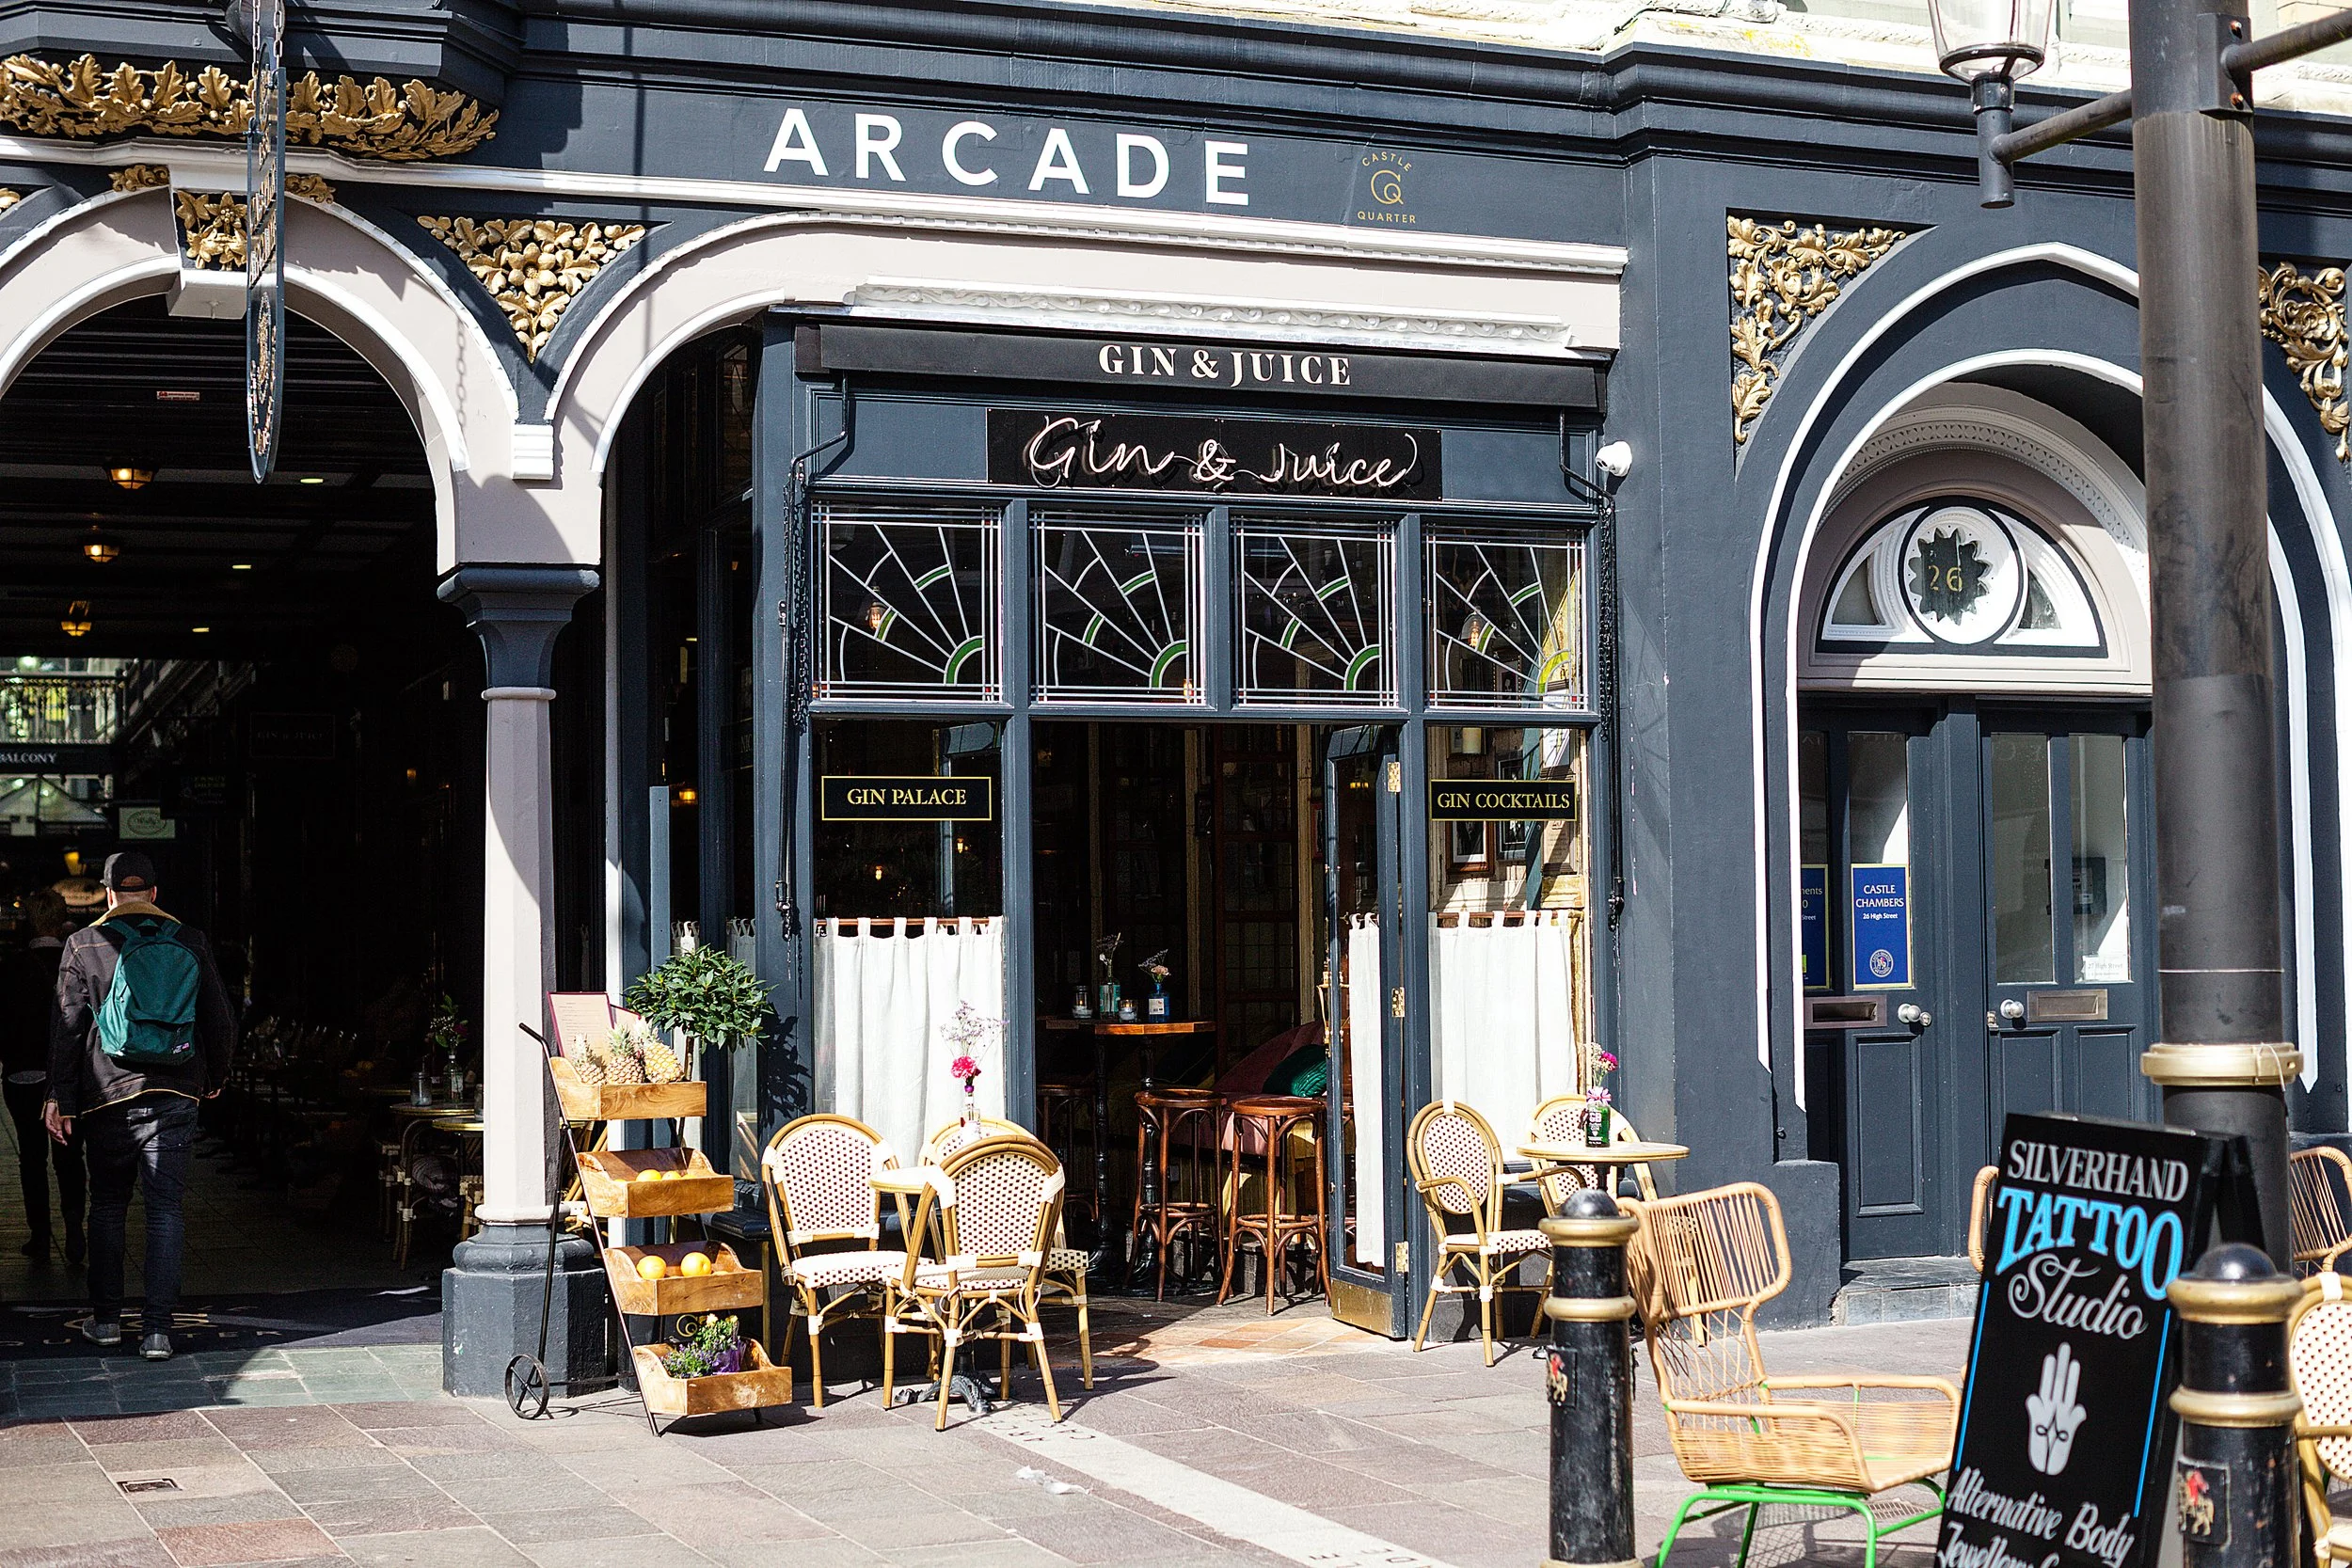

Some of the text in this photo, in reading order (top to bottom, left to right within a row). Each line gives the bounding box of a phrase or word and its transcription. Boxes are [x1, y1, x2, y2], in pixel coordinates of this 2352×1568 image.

[763, 107, 1249, 206] ARCADE
[1361, 151, 1412, 172] CASTLE
[1357, 211, 1417, 224] QUARTER
[1098, 344, 1352, 388] GIN & JUICE
[1028, 415, 1419, 487] Gin & Juice
[1928, 564, 1963, 592] 26
[0, 752, 57, 765] ALCONY
[847, 788, 967, 805] GIN PALACE
[1437, 793, 1570, 809] GIN COCKTAILS
[1863, 884, 1897, 895] CASTLE
[1855, 897, 1905, 908] CHAMBERS
[1870, 912, 1883, 921] High
[2008, 1138, 2189, 1203] SILVERHAND
[1994, 1185, 2185, 1302] TATTOO
[2007, 1251, 2150, 1340] Studio
[1945, 1465, 2136, 1568] Alternative Body
